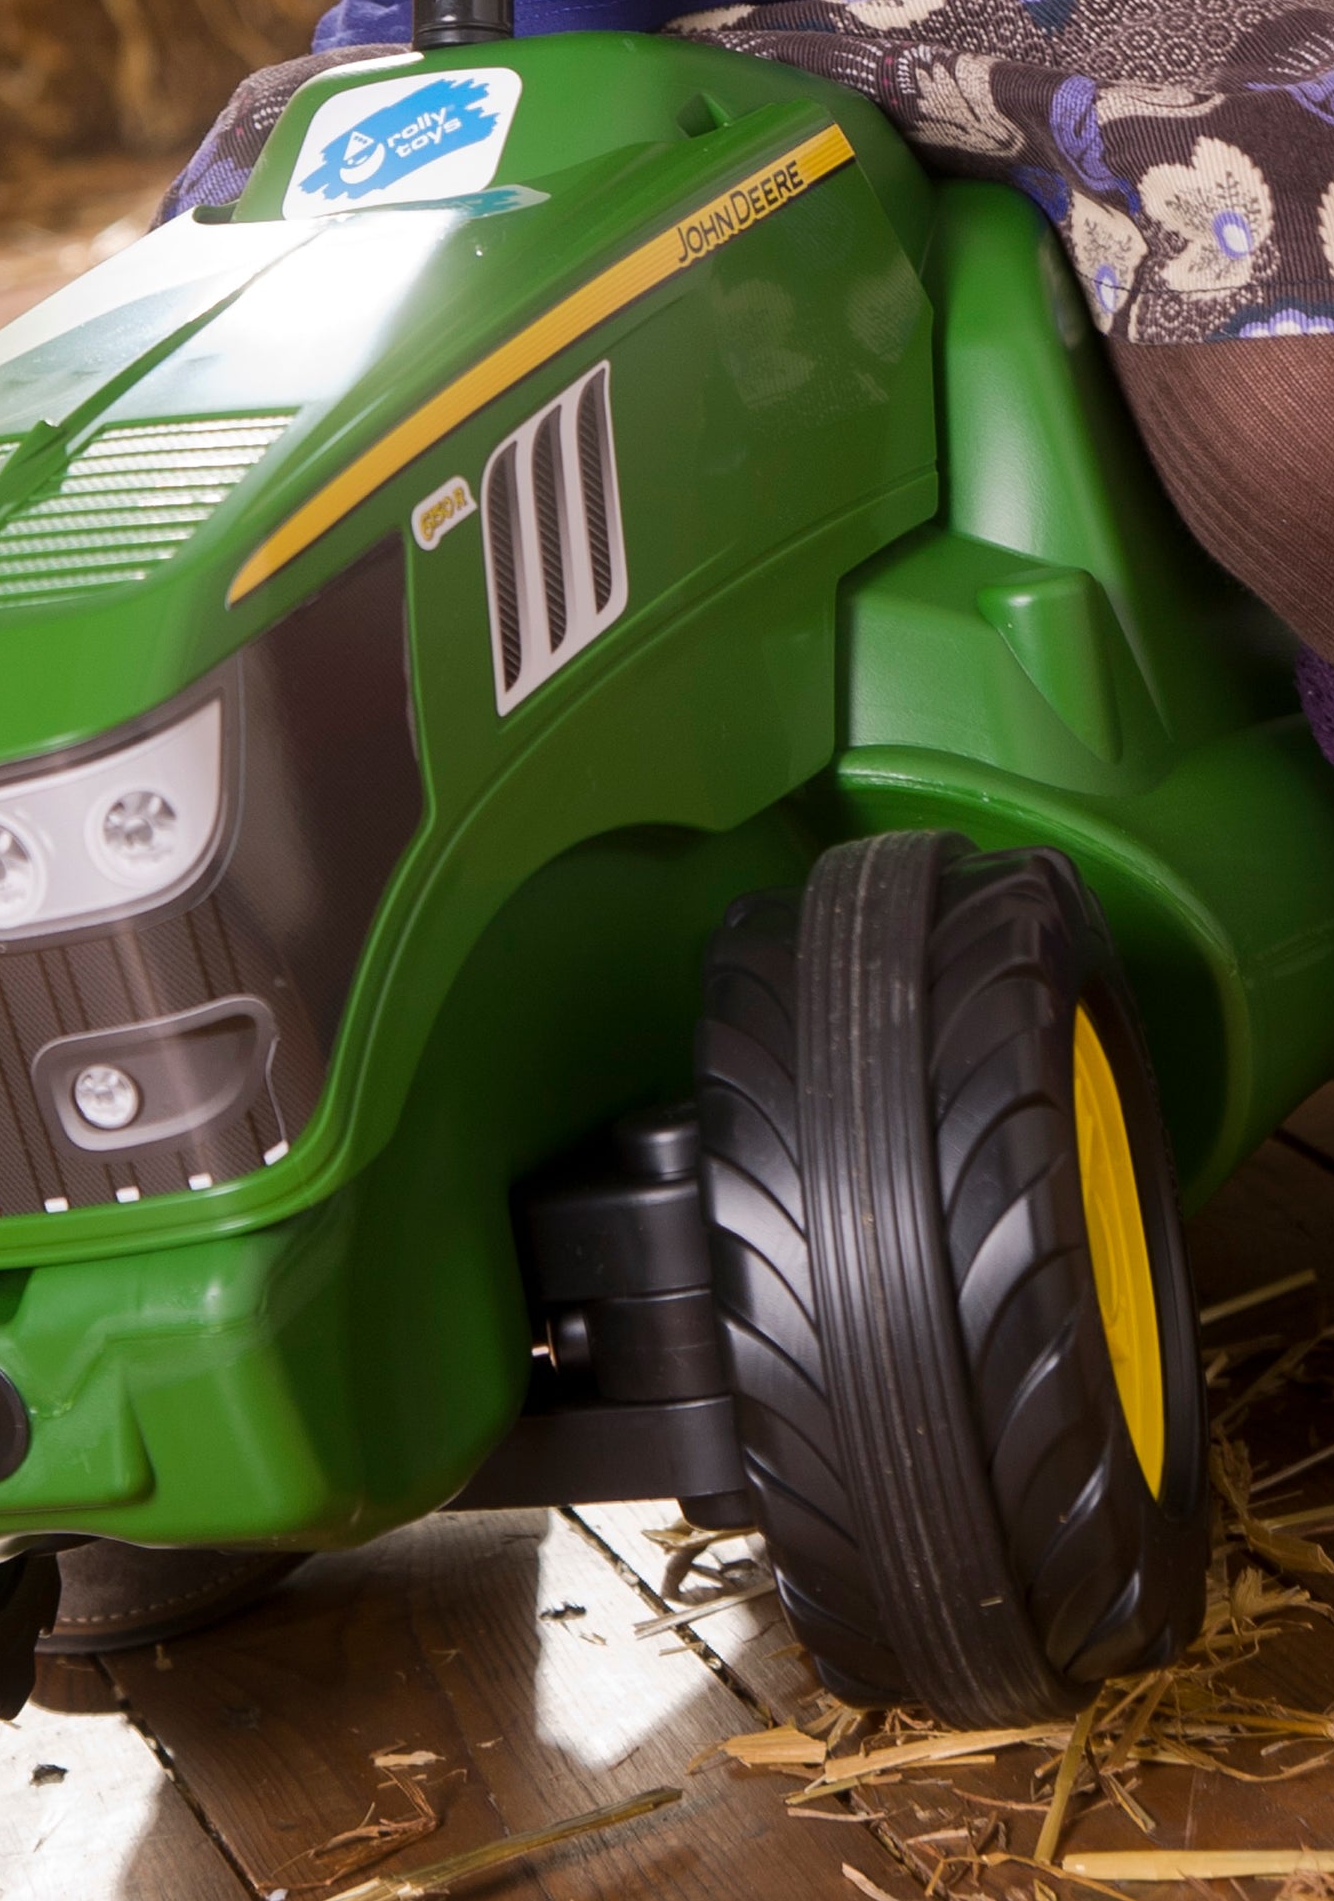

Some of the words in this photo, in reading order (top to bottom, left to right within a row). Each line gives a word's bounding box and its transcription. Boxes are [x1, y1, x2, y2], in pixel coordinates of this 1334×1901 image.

[387, 107, 446, 148] rolly
[395, 118, 462, 158] toys
[677, 205, 734, 263] JOHN
[729, 160, 804, 226] DEERE
